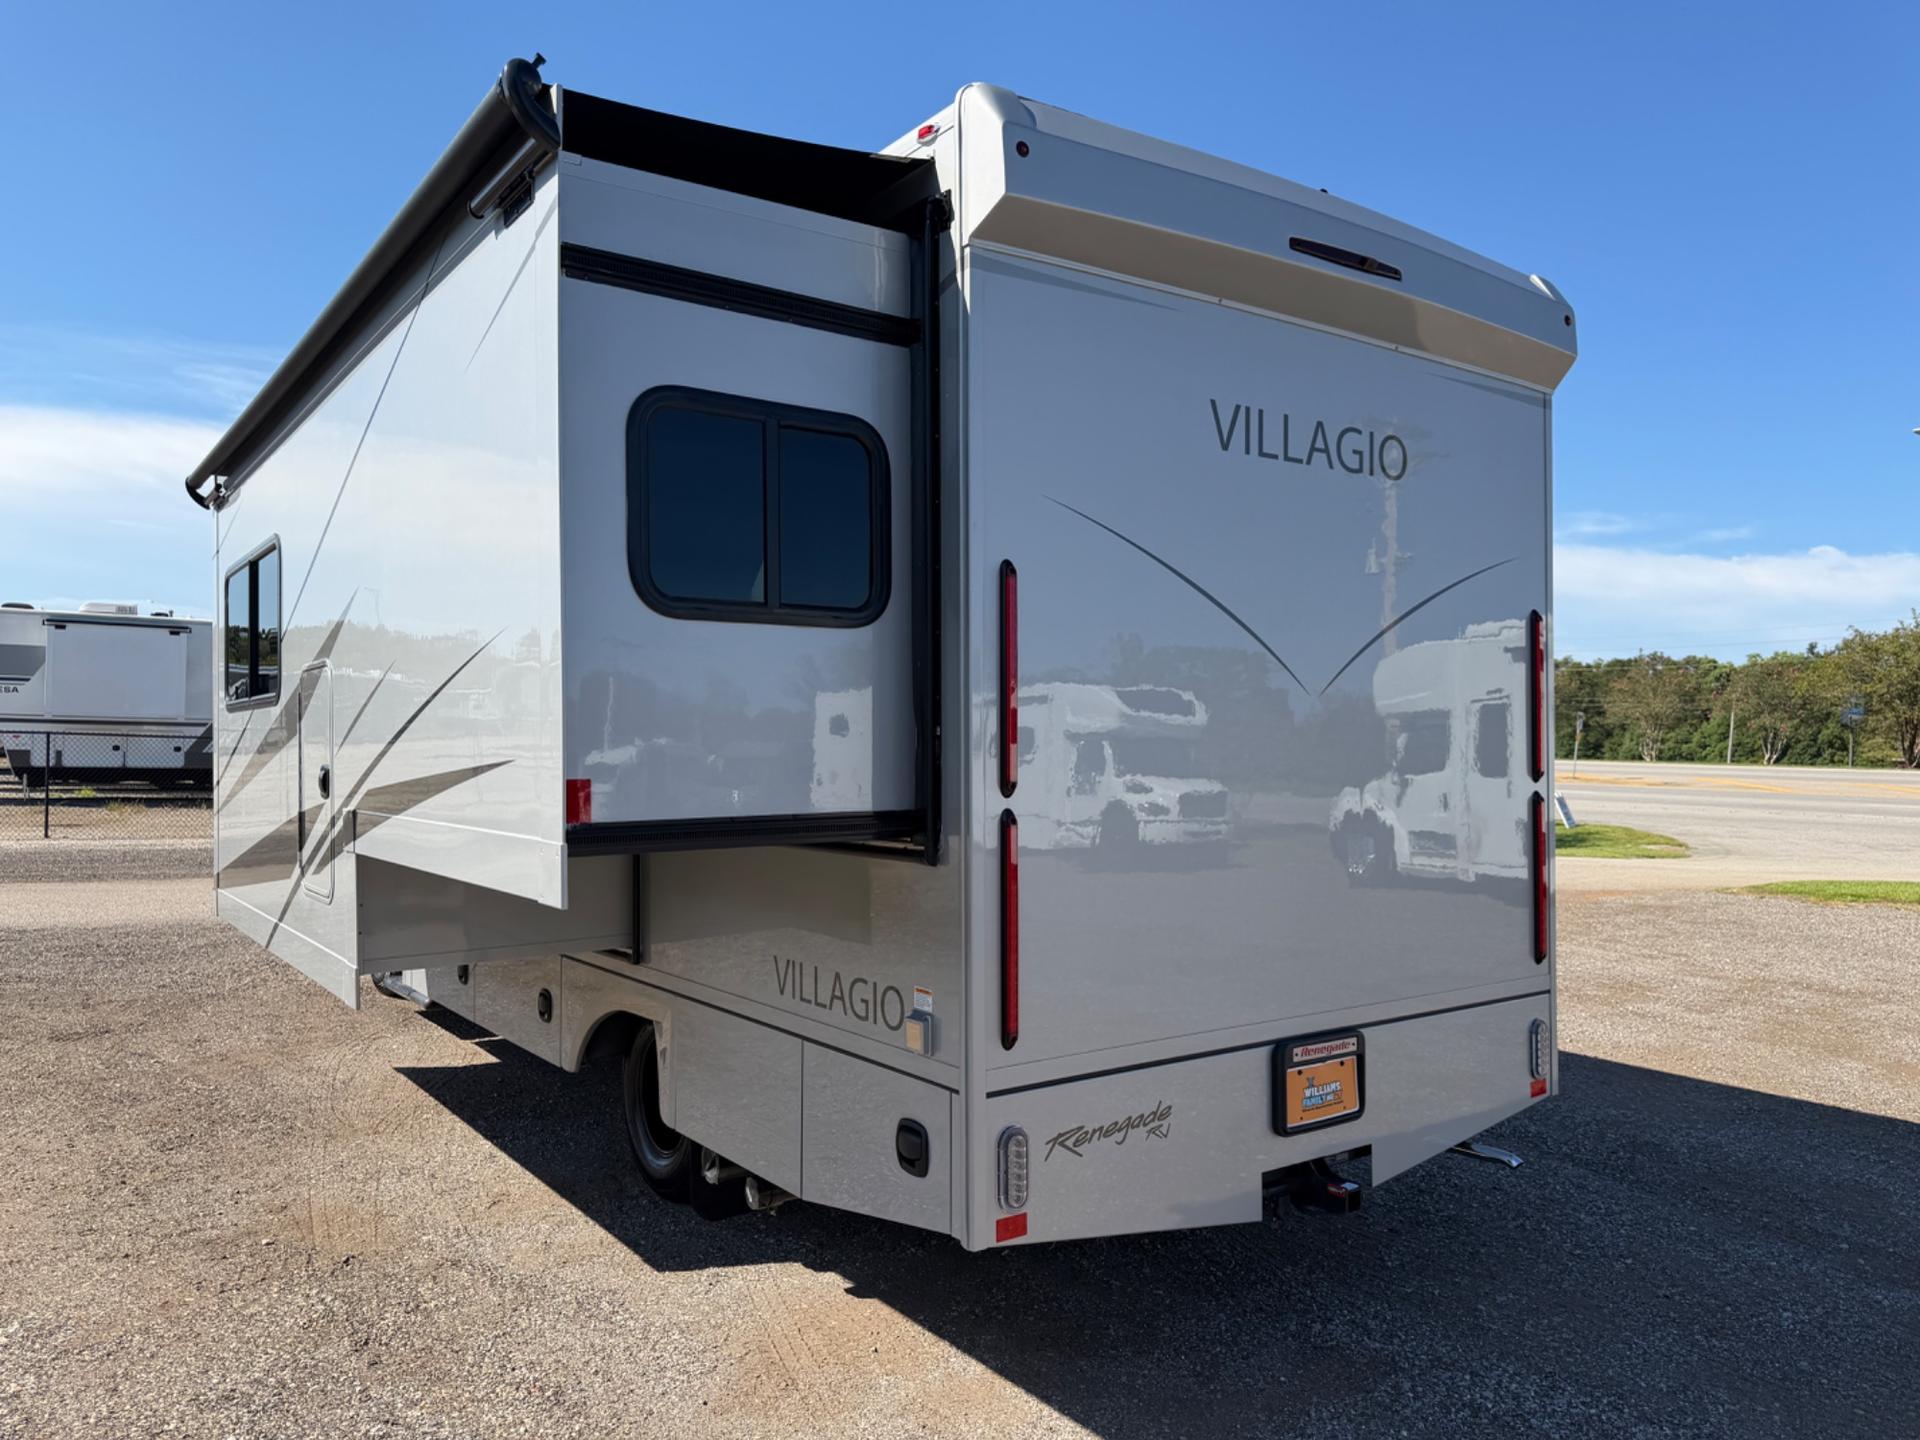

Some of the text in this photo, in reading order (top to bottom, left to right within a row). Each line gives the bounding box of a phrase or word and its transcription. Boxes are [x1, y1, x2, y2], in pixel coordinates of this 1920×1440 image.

[1209, 398, 1408, 481] VILLAGIO
[773, 955, 906, 1032] VILLAGIO
[1300, 1040, 1350, 1057] Renegade
[1303, 1081, 1341, 1097] WILLIAMS
[1044, 1100, 1173, 1162] Renegade
[1145, 1123, 1171, 1142] RV
